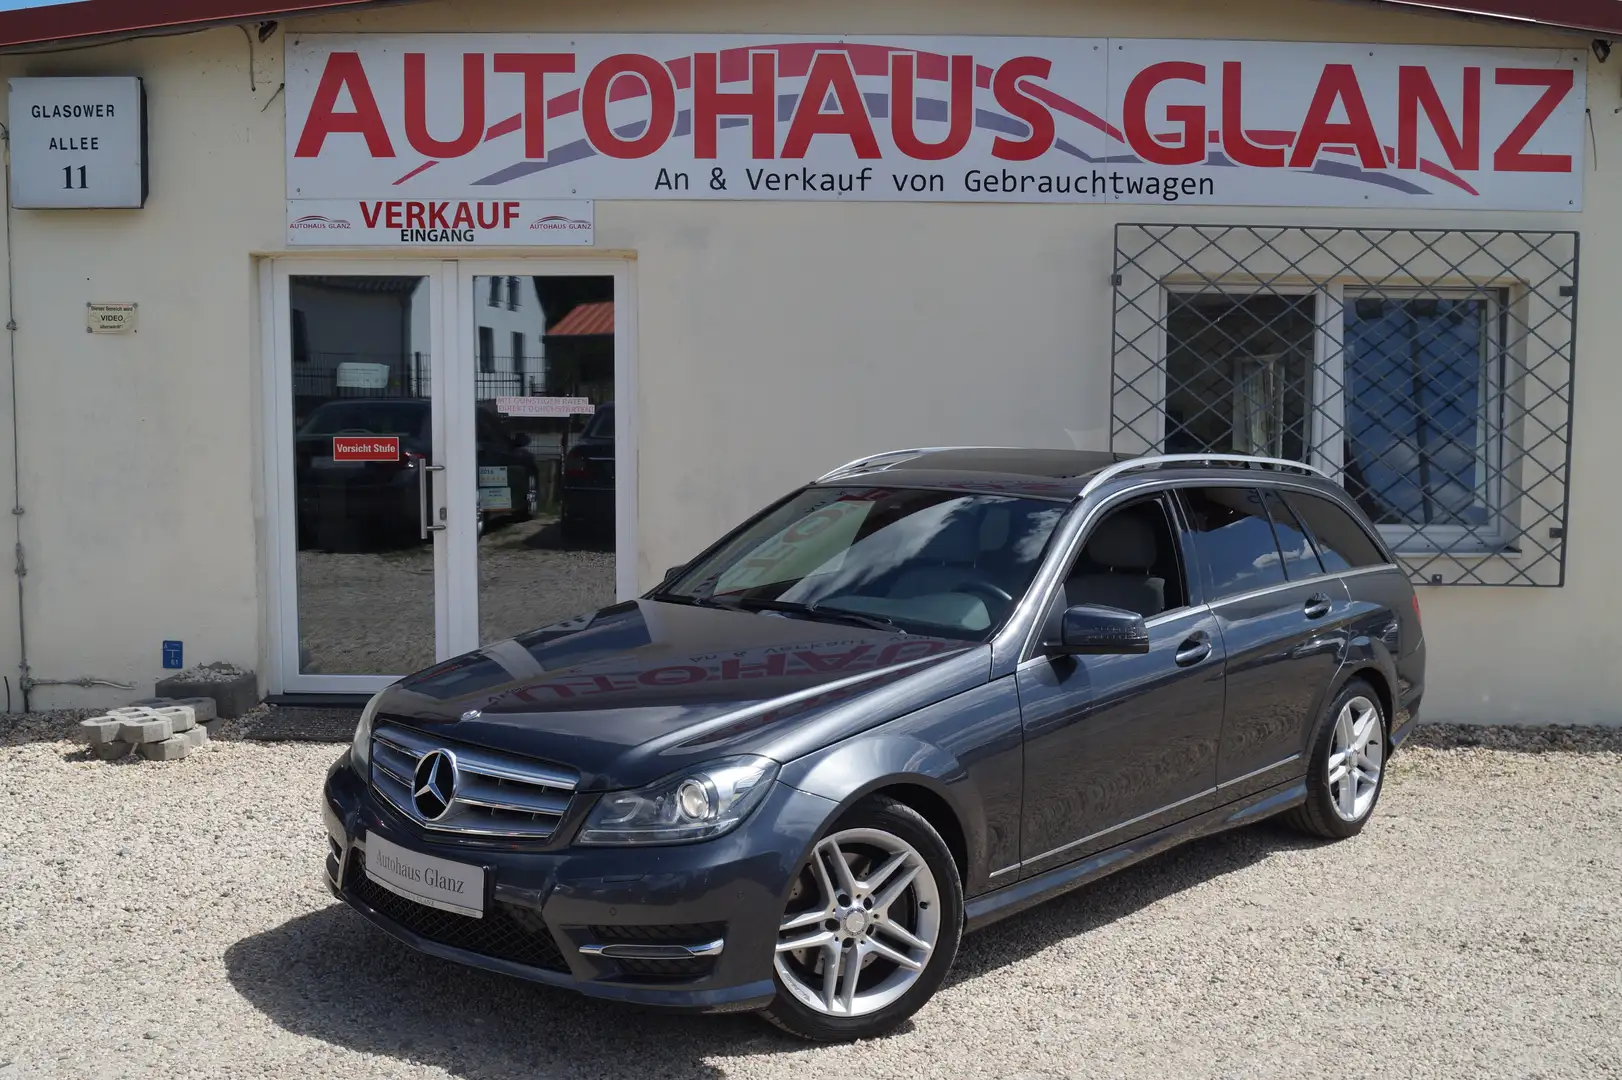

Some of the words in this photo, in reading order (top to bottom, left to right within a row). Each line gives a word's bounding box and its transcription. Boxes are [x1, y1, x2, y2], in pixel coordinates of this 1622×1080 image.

[31, 104, 115, 118] GLASOWER
[294, 51, 1056, 162] AUTOHAUS
[1123, 61, 1574, 173] GLANZ
[49, 137, 99, 150] ALLEE
[61, 165, 89, 189] 11
[654, 167, 690, 190] An
[709, 167, 728, 190] &
[745, 167, 873, 192] Verkauf
[892, 174, 944, 192] von
[964, 169, 1215, 201] Gebrauchtwagen
[359, 201, 520, 229] VERKAUF
[400, 229, 475, 243] EINGANG
[336, 443, 372, 453] Vorsicht
[373, 443, 396, 453] Stufe
[376, 849, 421, 883] Autohaus
[424, 867, 465, 894] Glanz
